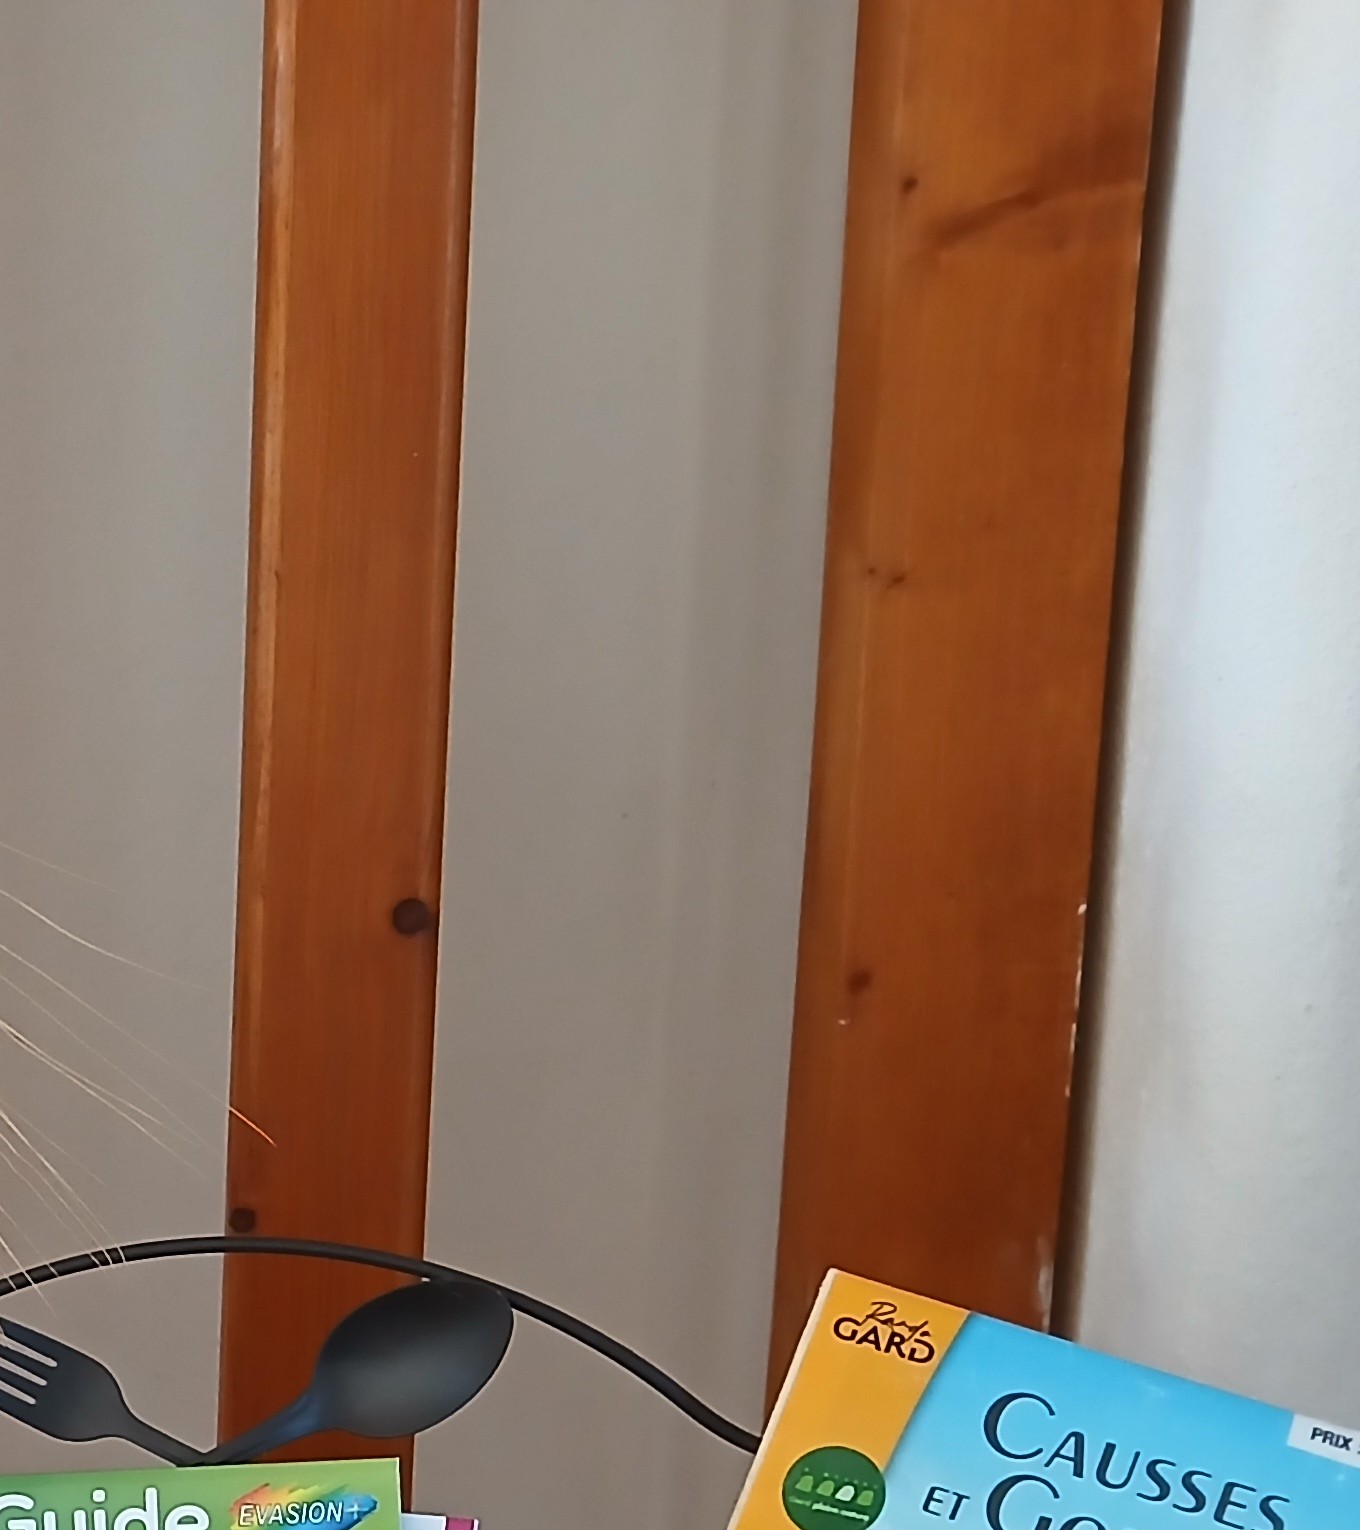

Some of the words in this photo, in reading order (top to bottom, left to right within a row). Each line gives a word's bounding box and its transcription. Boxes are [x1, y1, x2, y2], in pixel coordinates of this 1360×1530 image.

[834, 1317, 935, 1363] GARD
[1310, 1427, 1353, 1451] PRIX
[922, 1486, 970, 1521] ET
